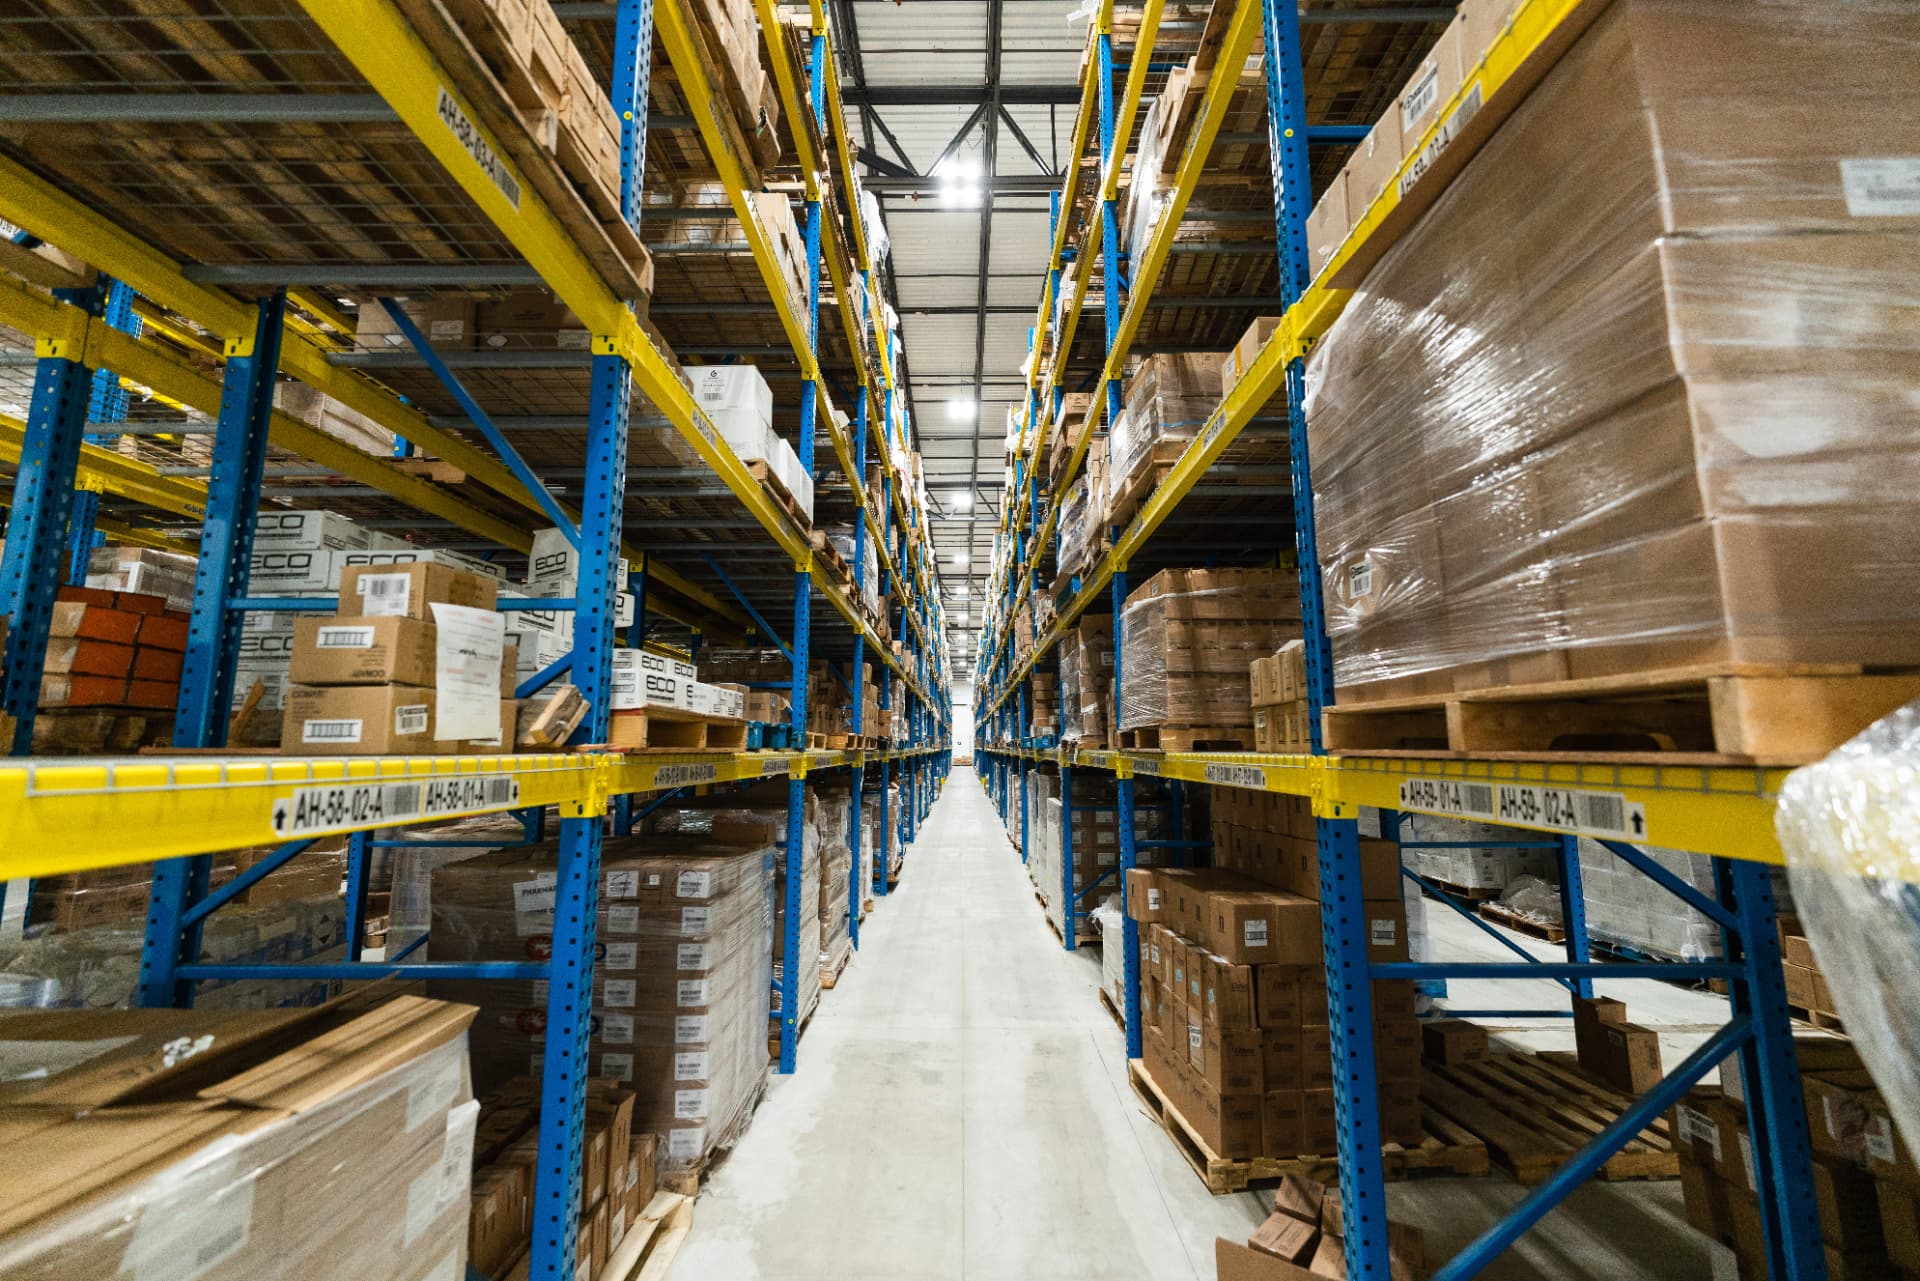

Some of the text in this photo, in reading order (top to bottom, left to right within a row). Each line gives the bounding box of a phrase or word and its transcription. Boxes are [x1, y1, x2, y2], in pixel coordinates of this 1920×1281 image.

[439, 92, 496, 181] AH-58-03-A
[536, 551, 567, 570] ECO
[642, 655, 664, 672] ECO
[674, 662, 694, 678] ECO
[646, 674, 676, 693] ECO
[294, 780, 486, 828] AH-58-02-A AH-58-01-A
[1408, 780, 1578, 827] AH-59-01-A AH-59-02-A
